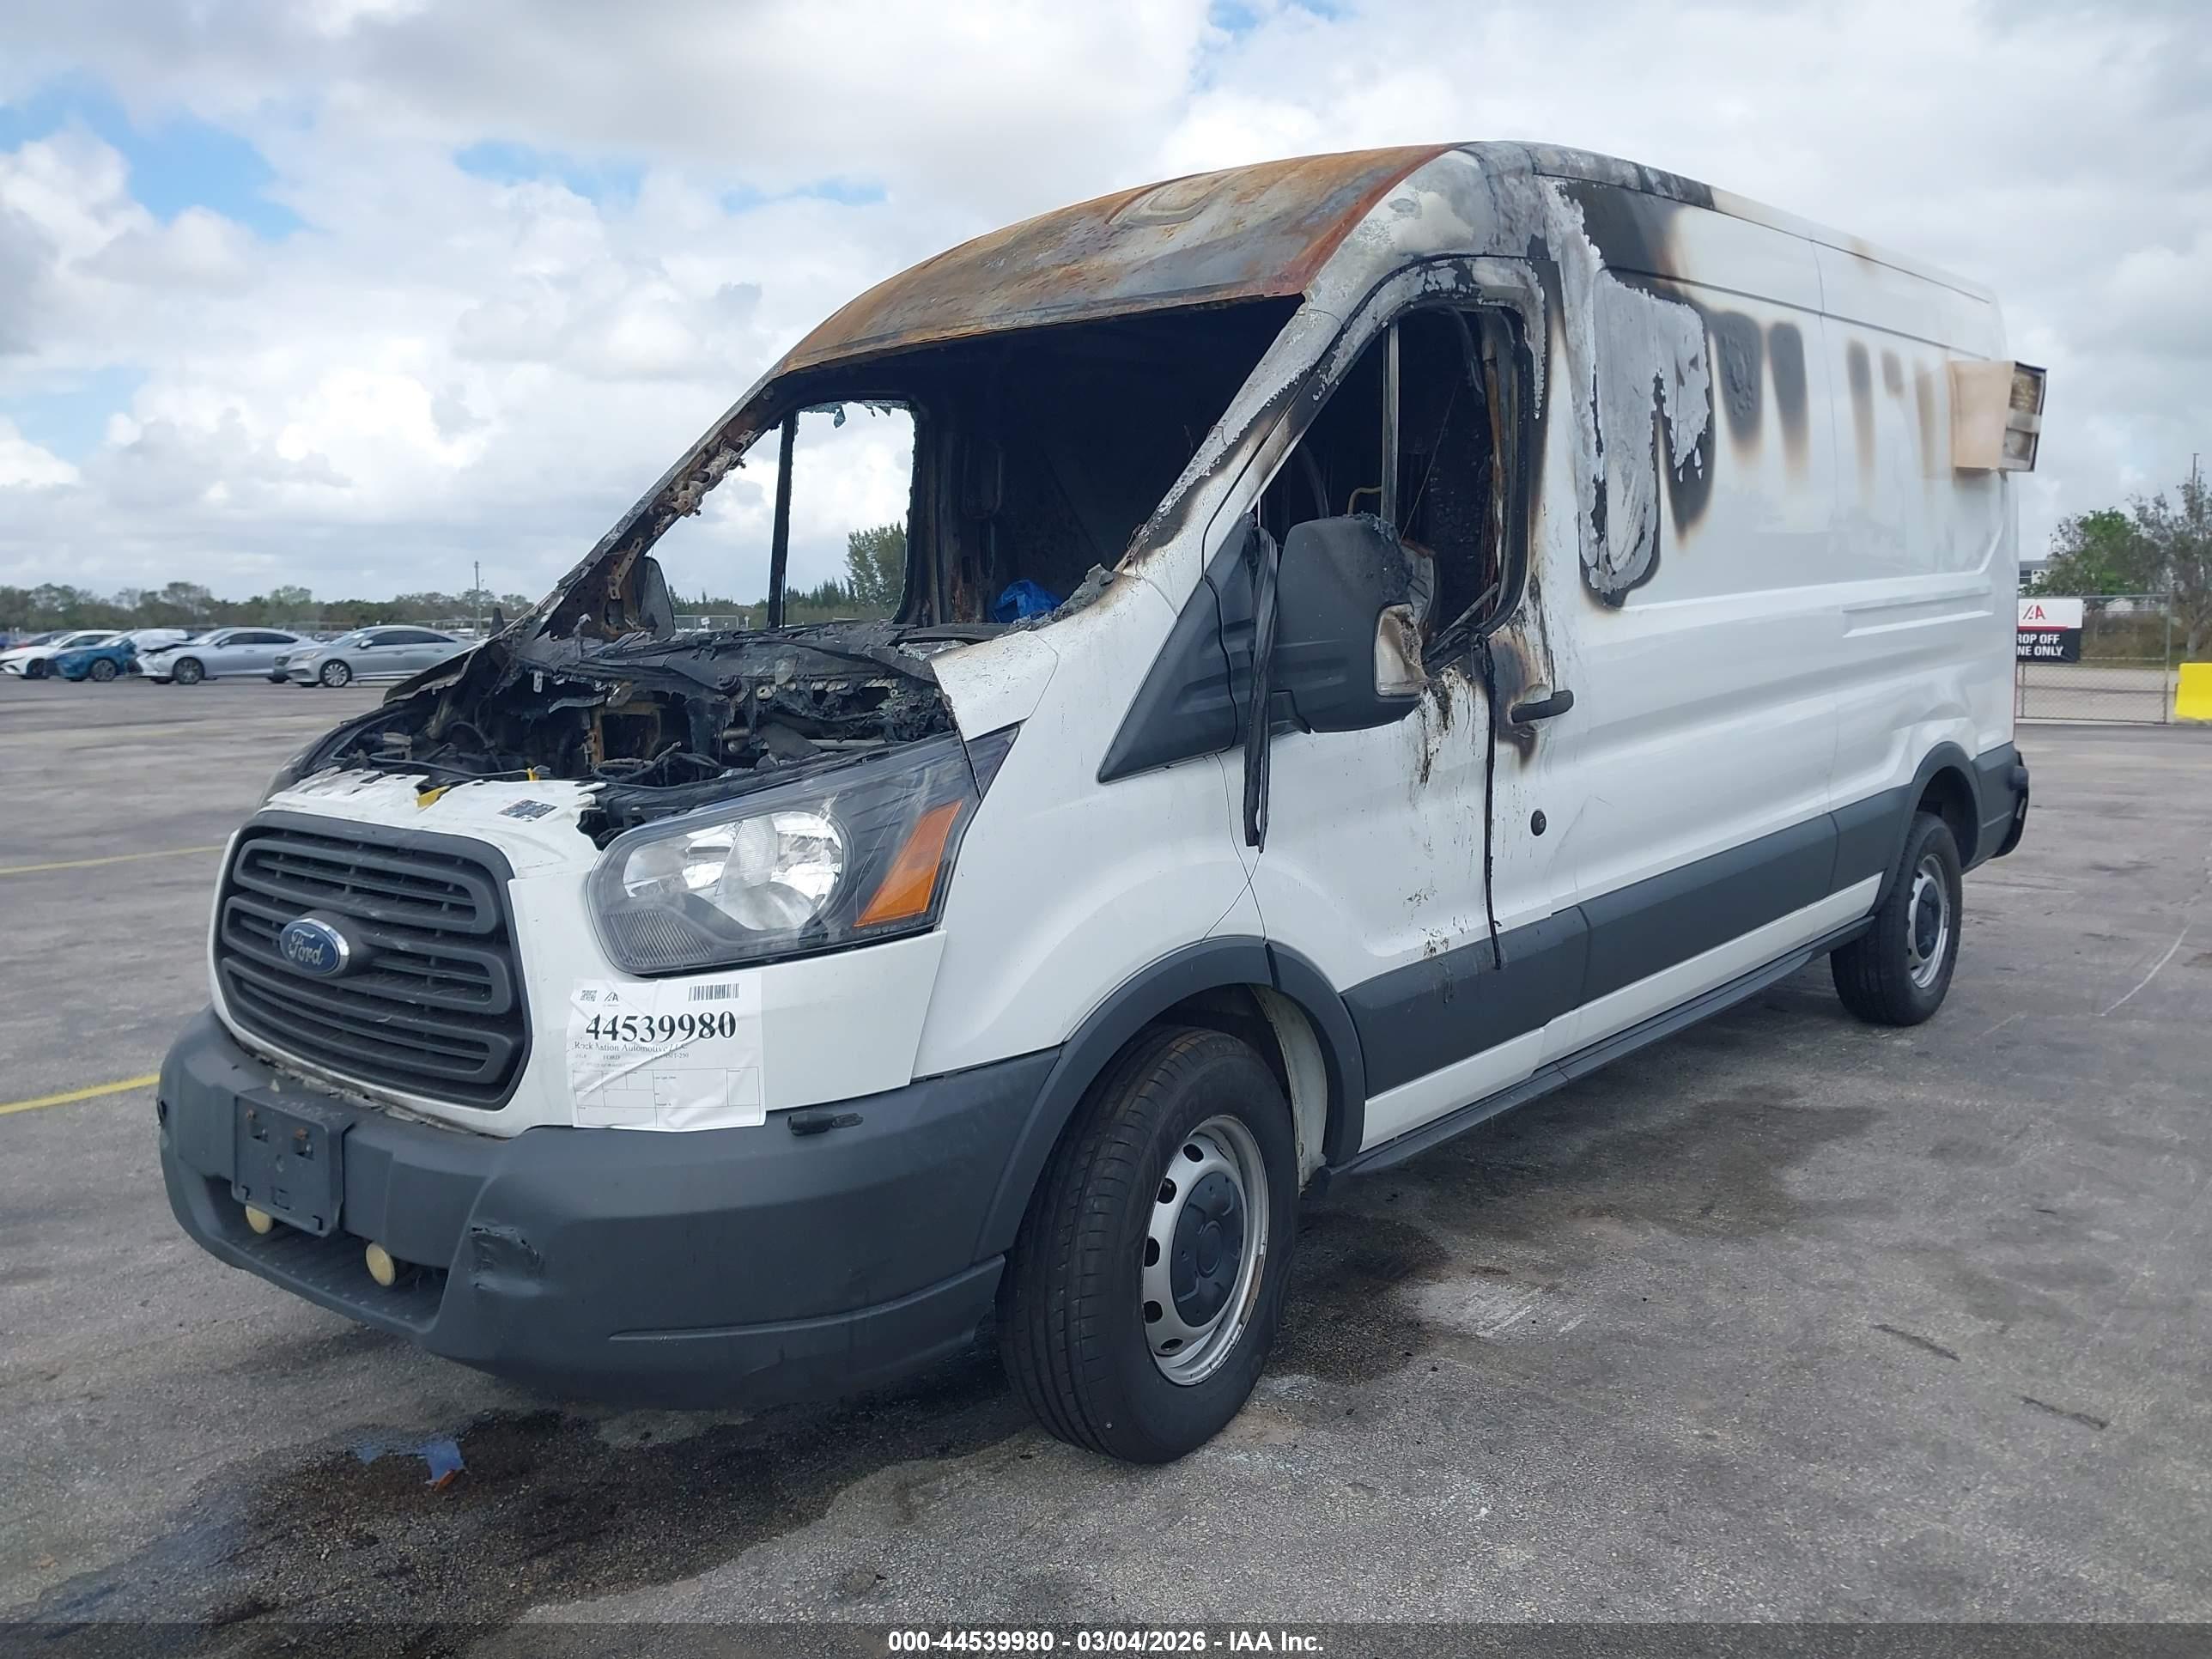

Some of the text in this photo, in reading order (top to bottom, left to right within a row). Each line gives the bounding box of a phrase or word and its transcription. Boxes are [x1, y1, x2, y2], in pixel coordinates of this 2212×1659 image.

[2017, 634, 2060, 644] ROP OFF
[2017, 646, 2063, 656] NE ONLY
[288, 929, 324, 966] Ford
[586, 1011, 737, 1043] 44539980
